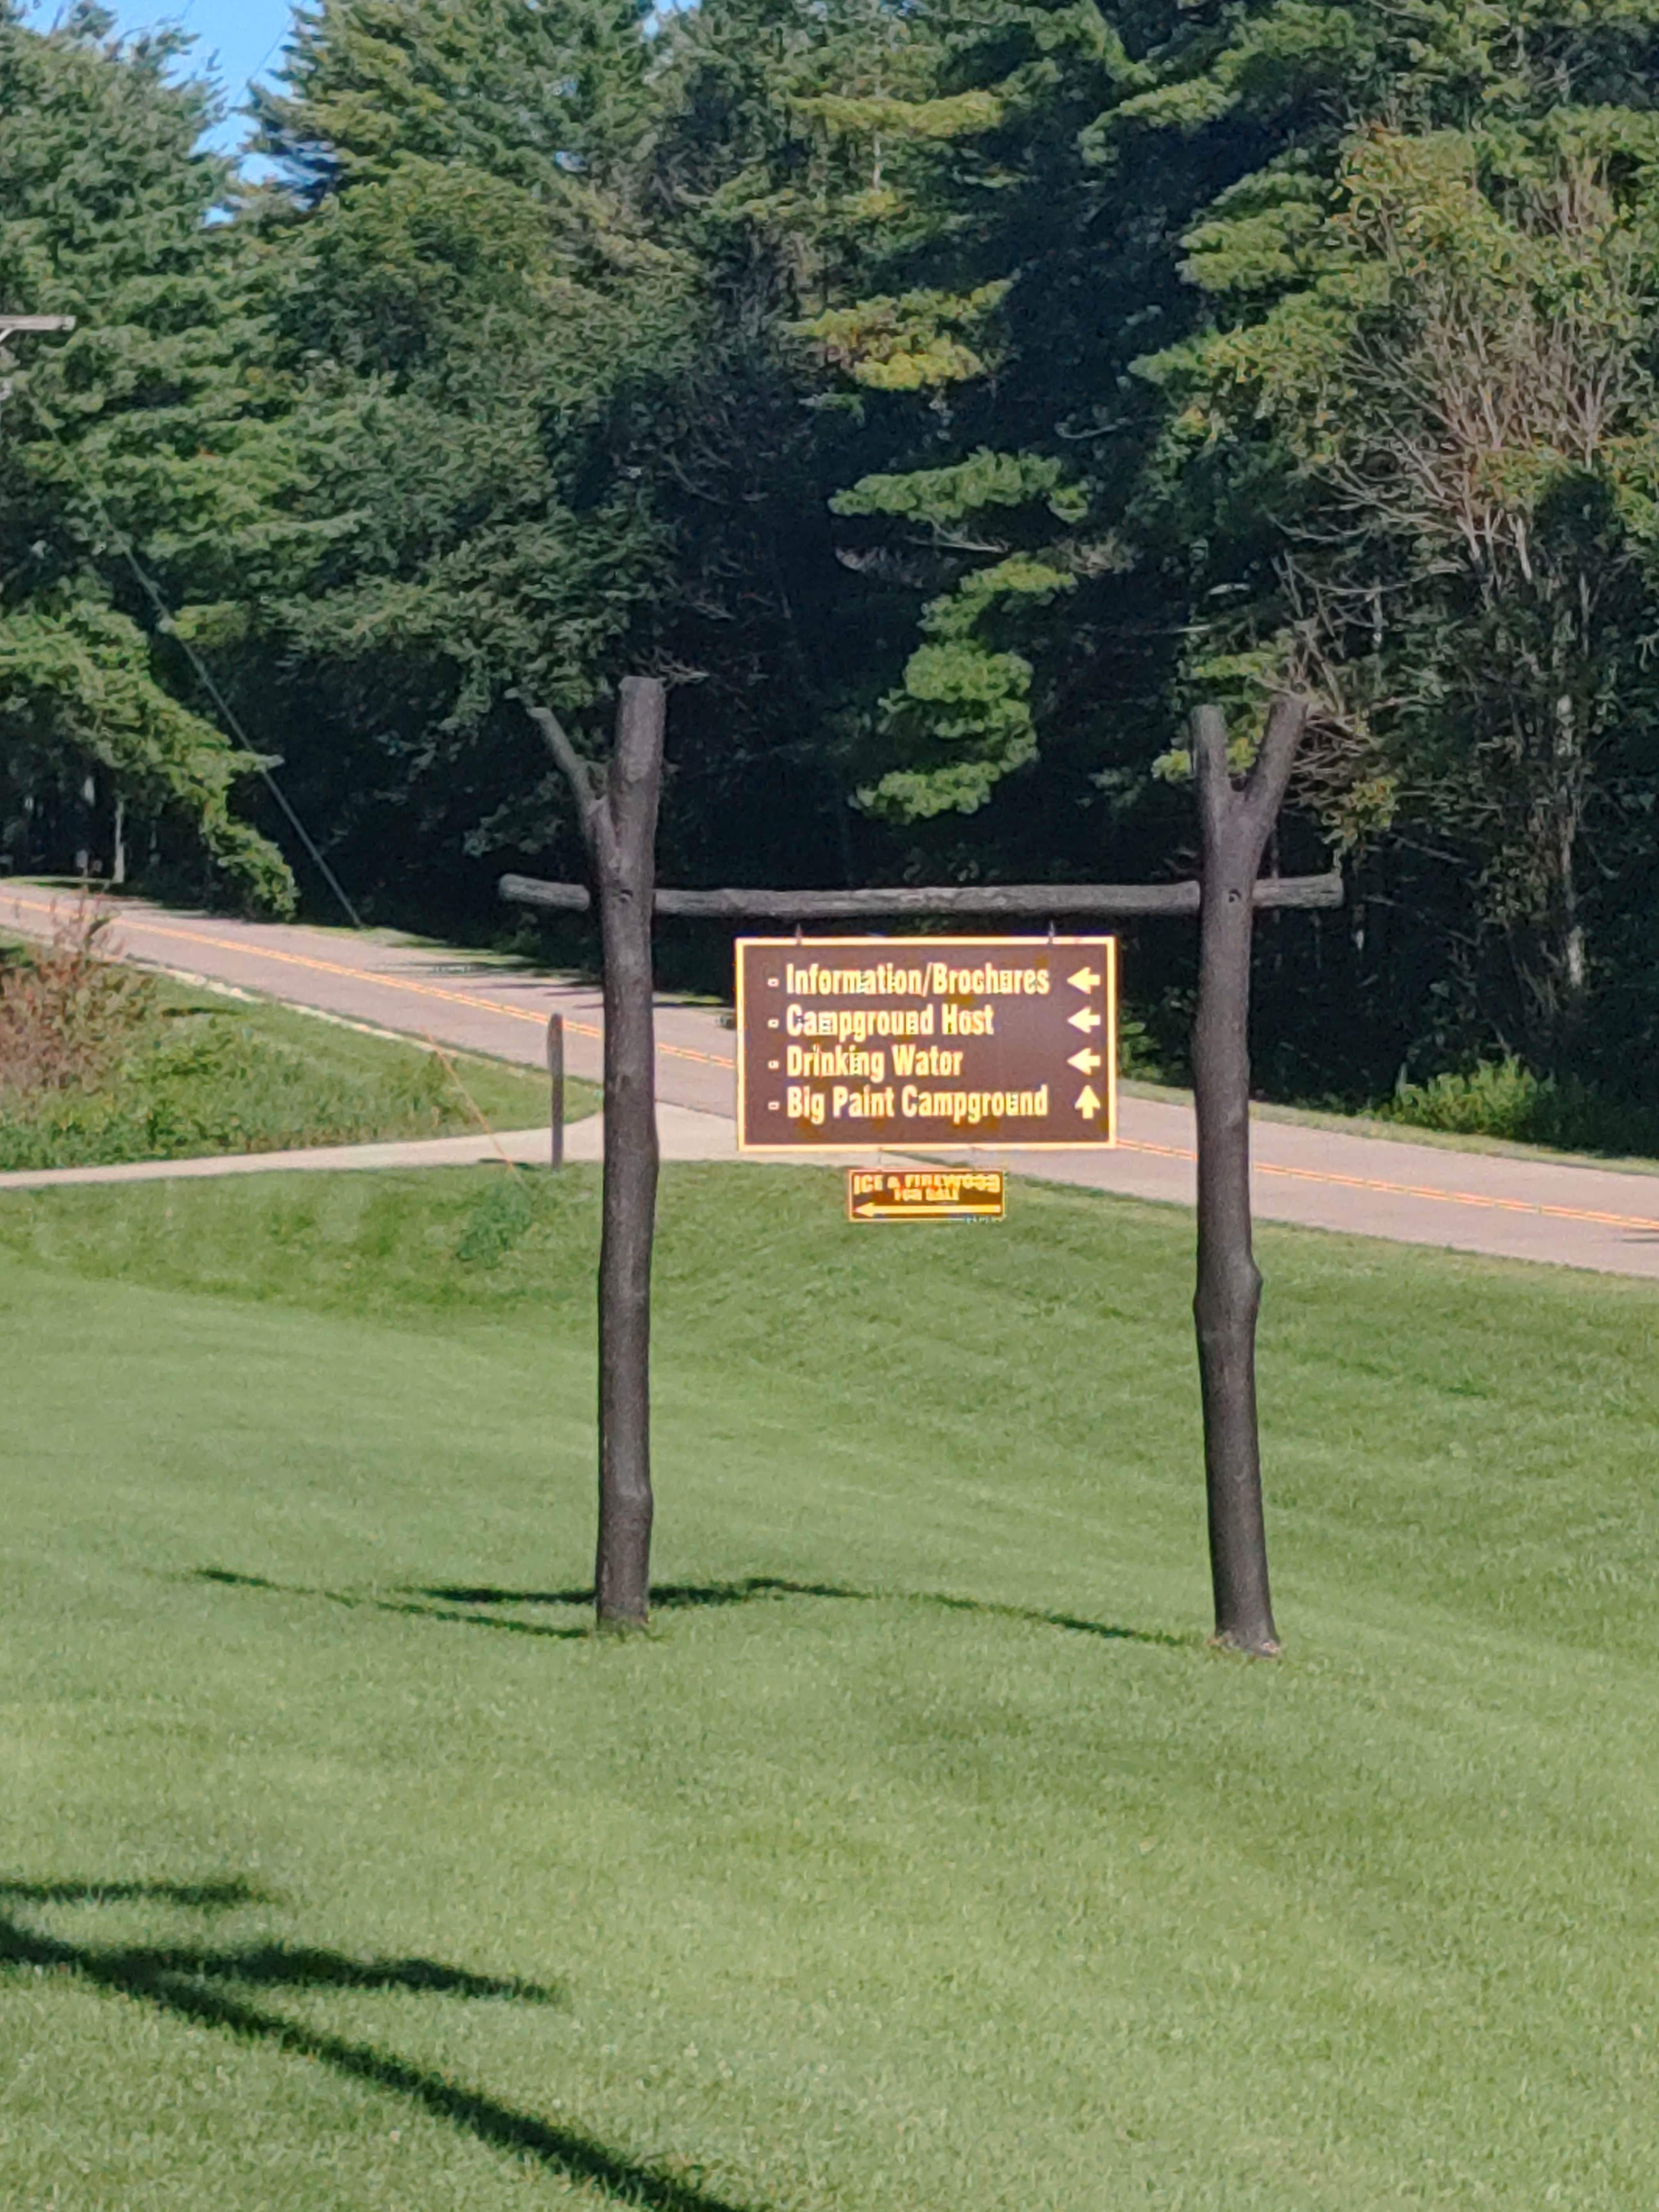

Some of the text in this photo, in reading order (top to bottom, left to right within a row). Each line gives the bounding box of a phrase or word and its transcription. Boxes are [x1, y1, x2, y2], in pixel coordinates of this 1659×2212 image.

[786, 962, 1049, 997] Information/Brochures
[787, 1003, 994, 1042] Campground Host
[787, 1044, 963, 1083] Drinking Water
[787, 1084, 1048, 1124] Big Paint Campground
